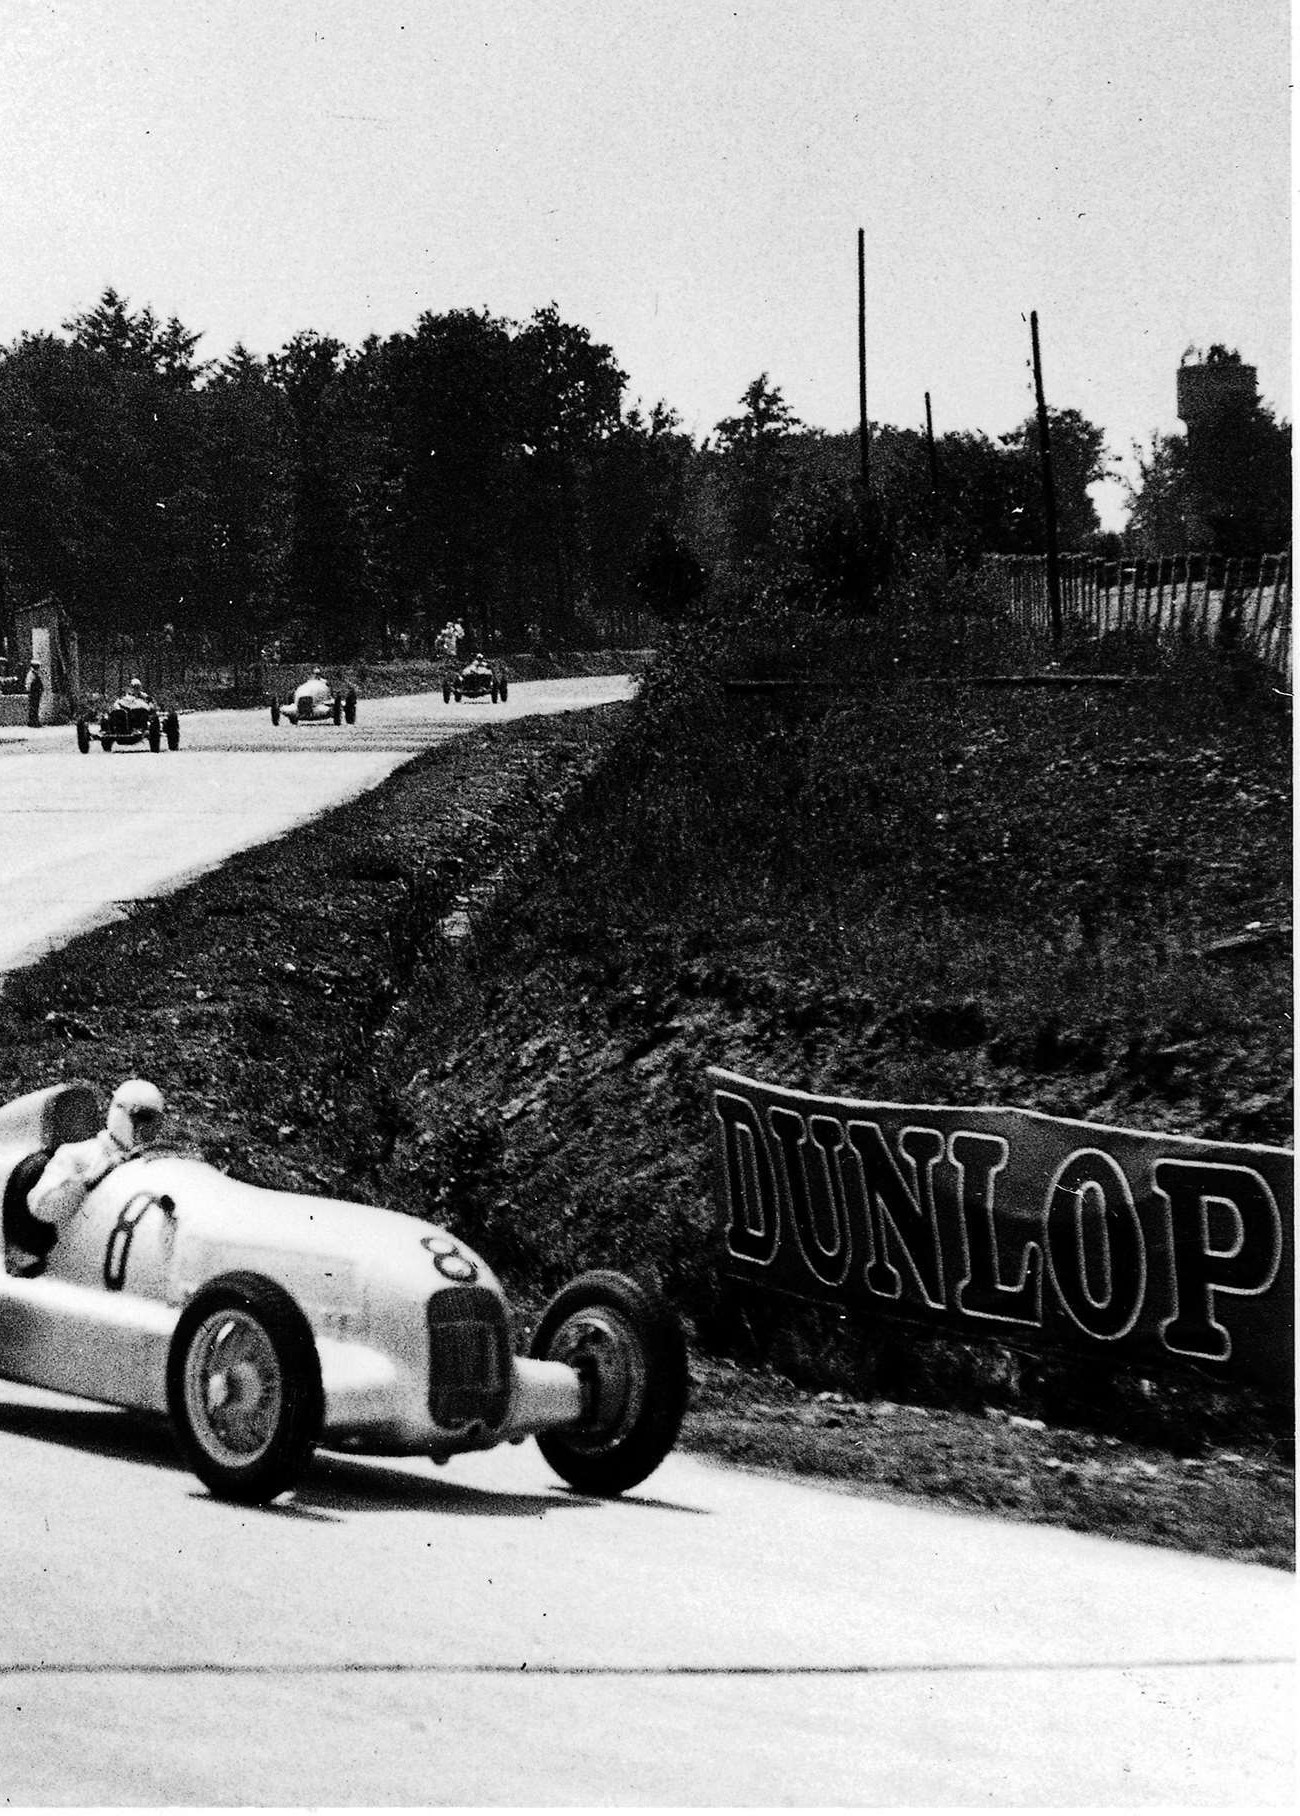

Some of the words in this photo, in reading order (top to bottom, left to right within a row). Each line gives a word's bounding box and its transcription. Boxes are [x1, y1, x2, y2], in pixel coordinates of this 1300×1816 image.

[102, 1190, 159, 1292] 8
[420, 1237, 478, 1283] 8
[714, 1089, 1283, 1361] DUNLOP
